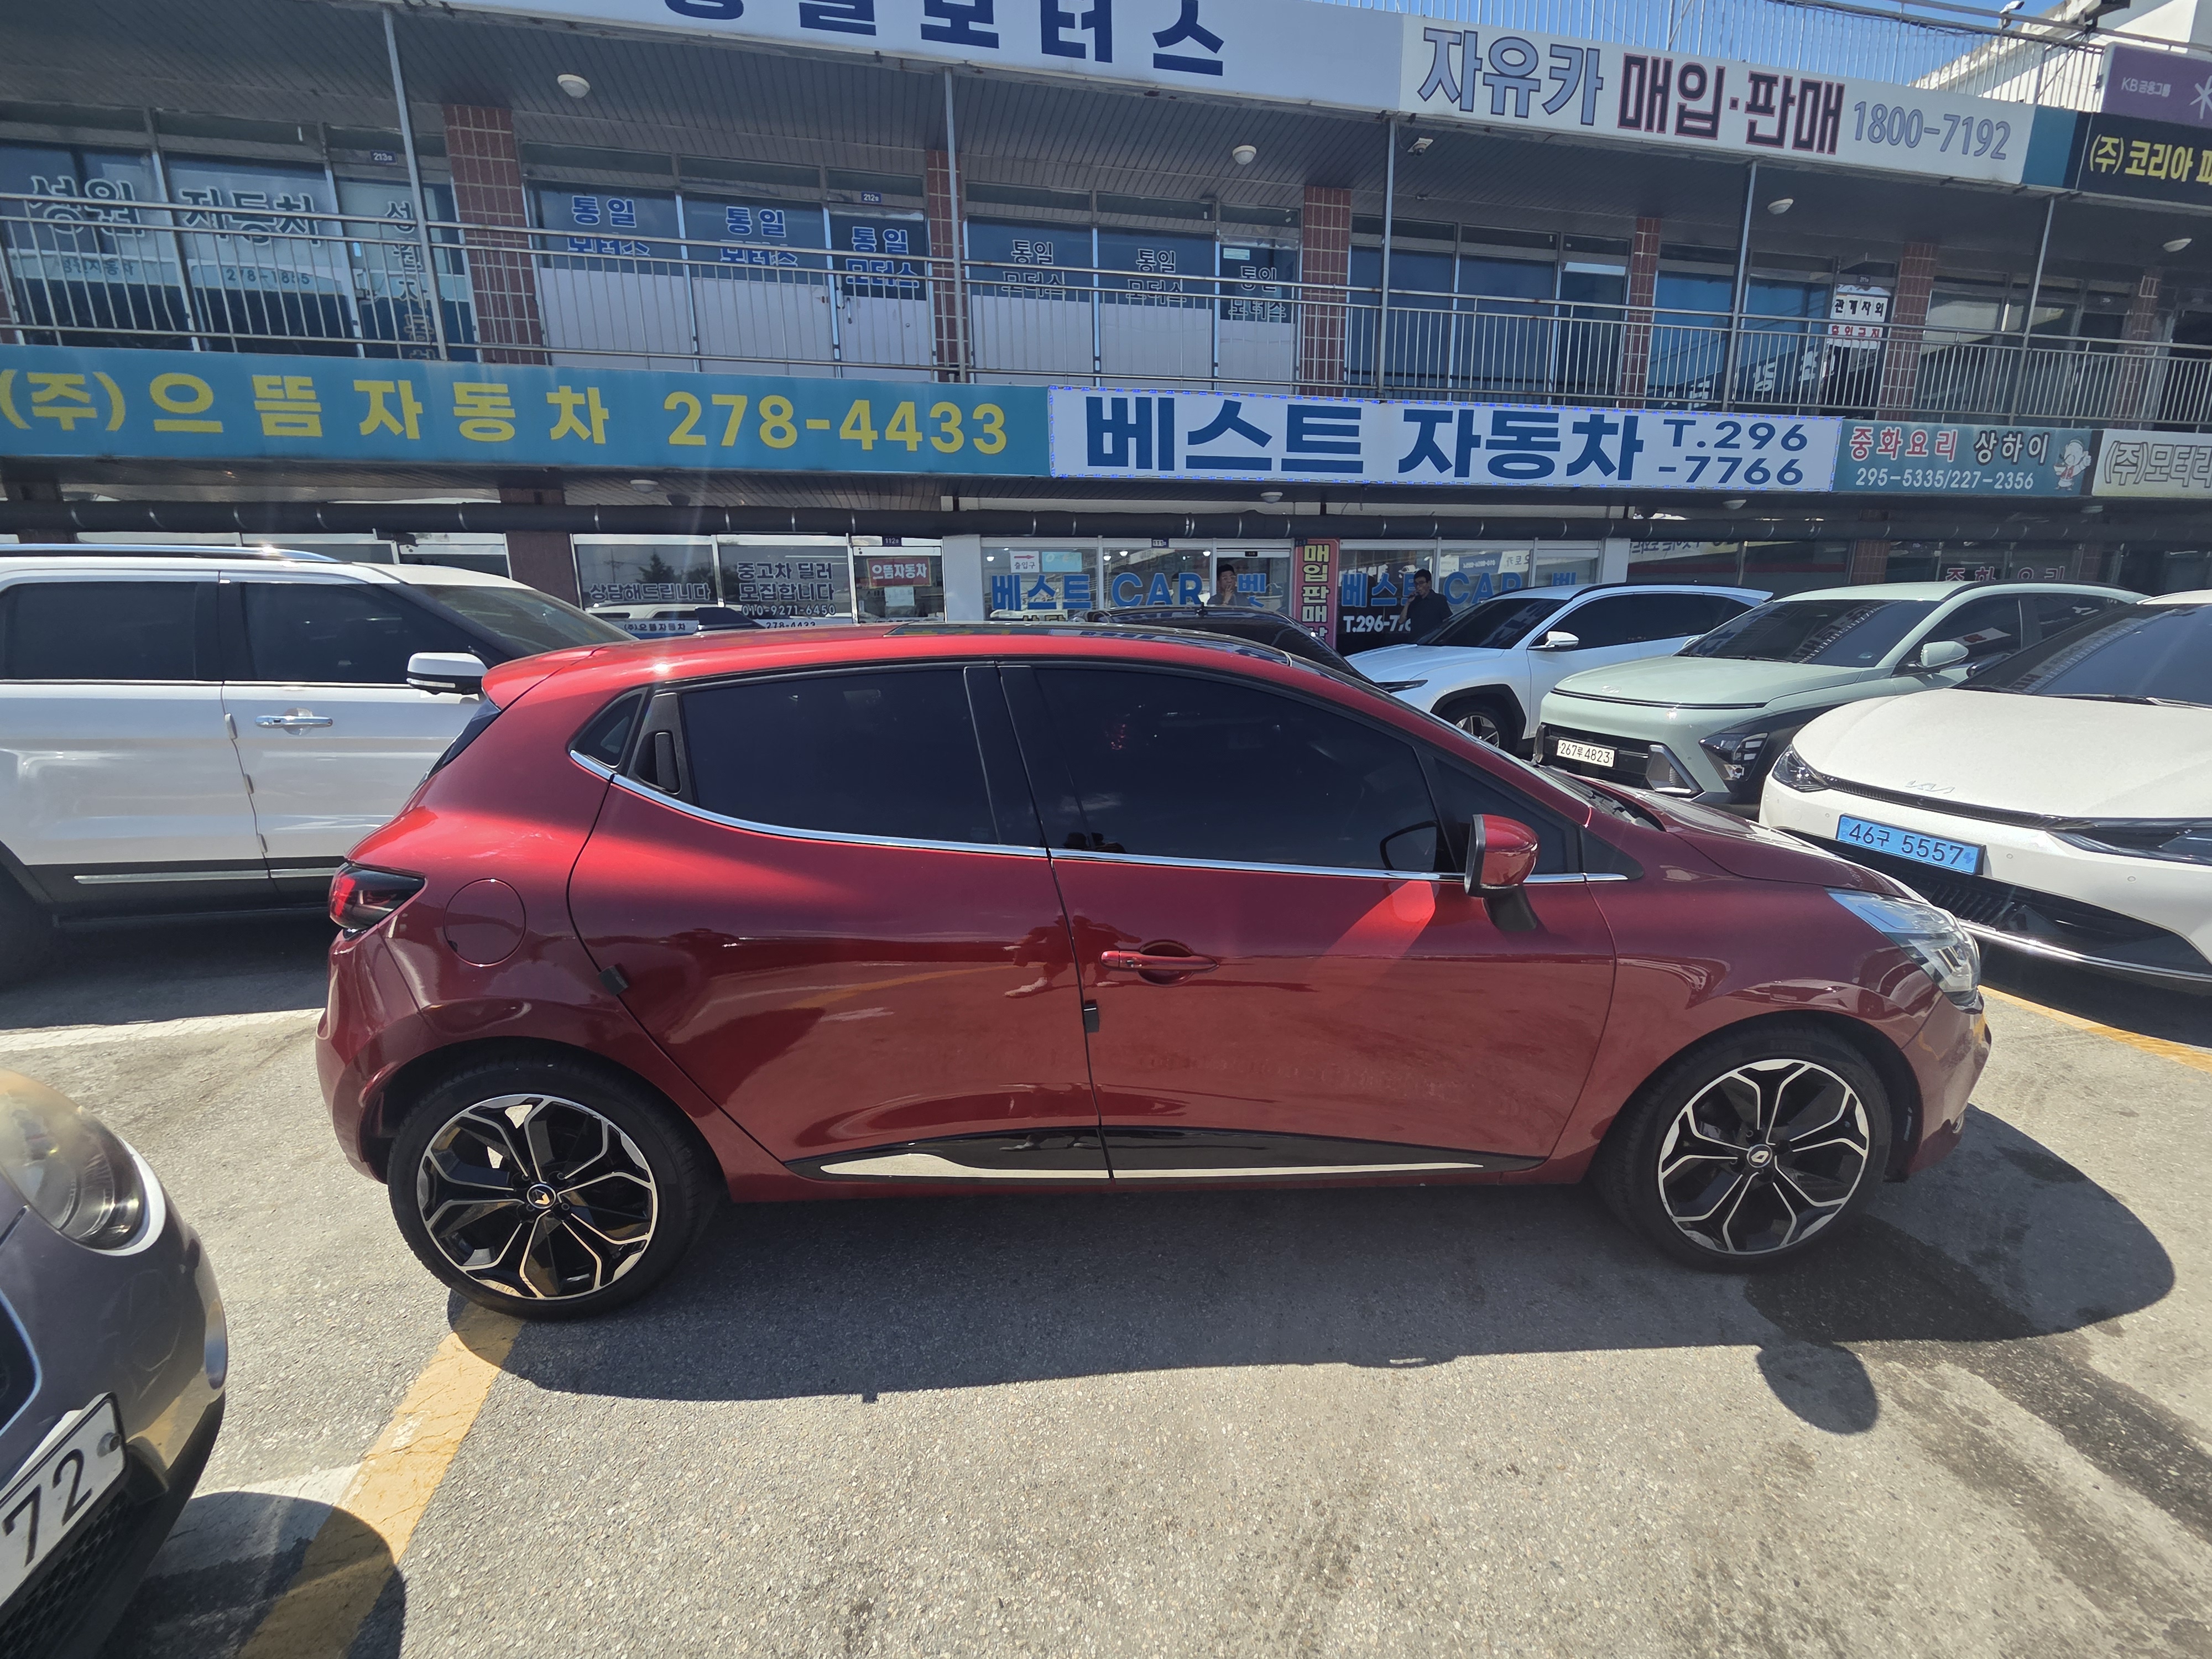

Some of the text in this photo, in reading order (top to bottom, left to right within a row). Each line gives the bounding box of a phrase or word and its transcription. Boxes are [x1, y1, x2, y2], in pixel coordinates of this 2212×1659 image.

[1417, 27, 1604, 126] 자유카
[1854, 101, 2012, 160] 1800-7192
[571, 195, 637, 228] 통일
[726, 206, 787, 238] 통일
[852, 226, 909, 255] 통일
[1010, 239, 1054, 264] 통일
[1135, 248, 1176, 273] 통일
[1240, 266, 1277, 293] 통일
[664, 391, 1008, 455] 278-4433
[1086, 397, 1808, 481] 베스트 자동차 T.296
[1850, 426, 2051, 466] 중화요리 상하이
[1658, 455, 1804, 486] -7766
[1855, 467, 2034, 491] 295-5335/227-2356
[737, 561, 833, 580] 중고차 딜러
[872, 562, 927, 580] 으뜸자동차
[589, 582, 711, 601] 상담해드립니다
[739, 582, 835, 602] 모집합니다
[991, 573, 1093, 612] 베스트
[1111, 572, 1203, 608] CAR
[742, 604, 836, 617] 010-9271-6450
[1849, 823, 1964, 865] 46구 5557
[2, 1448, 93, 1568] 72
